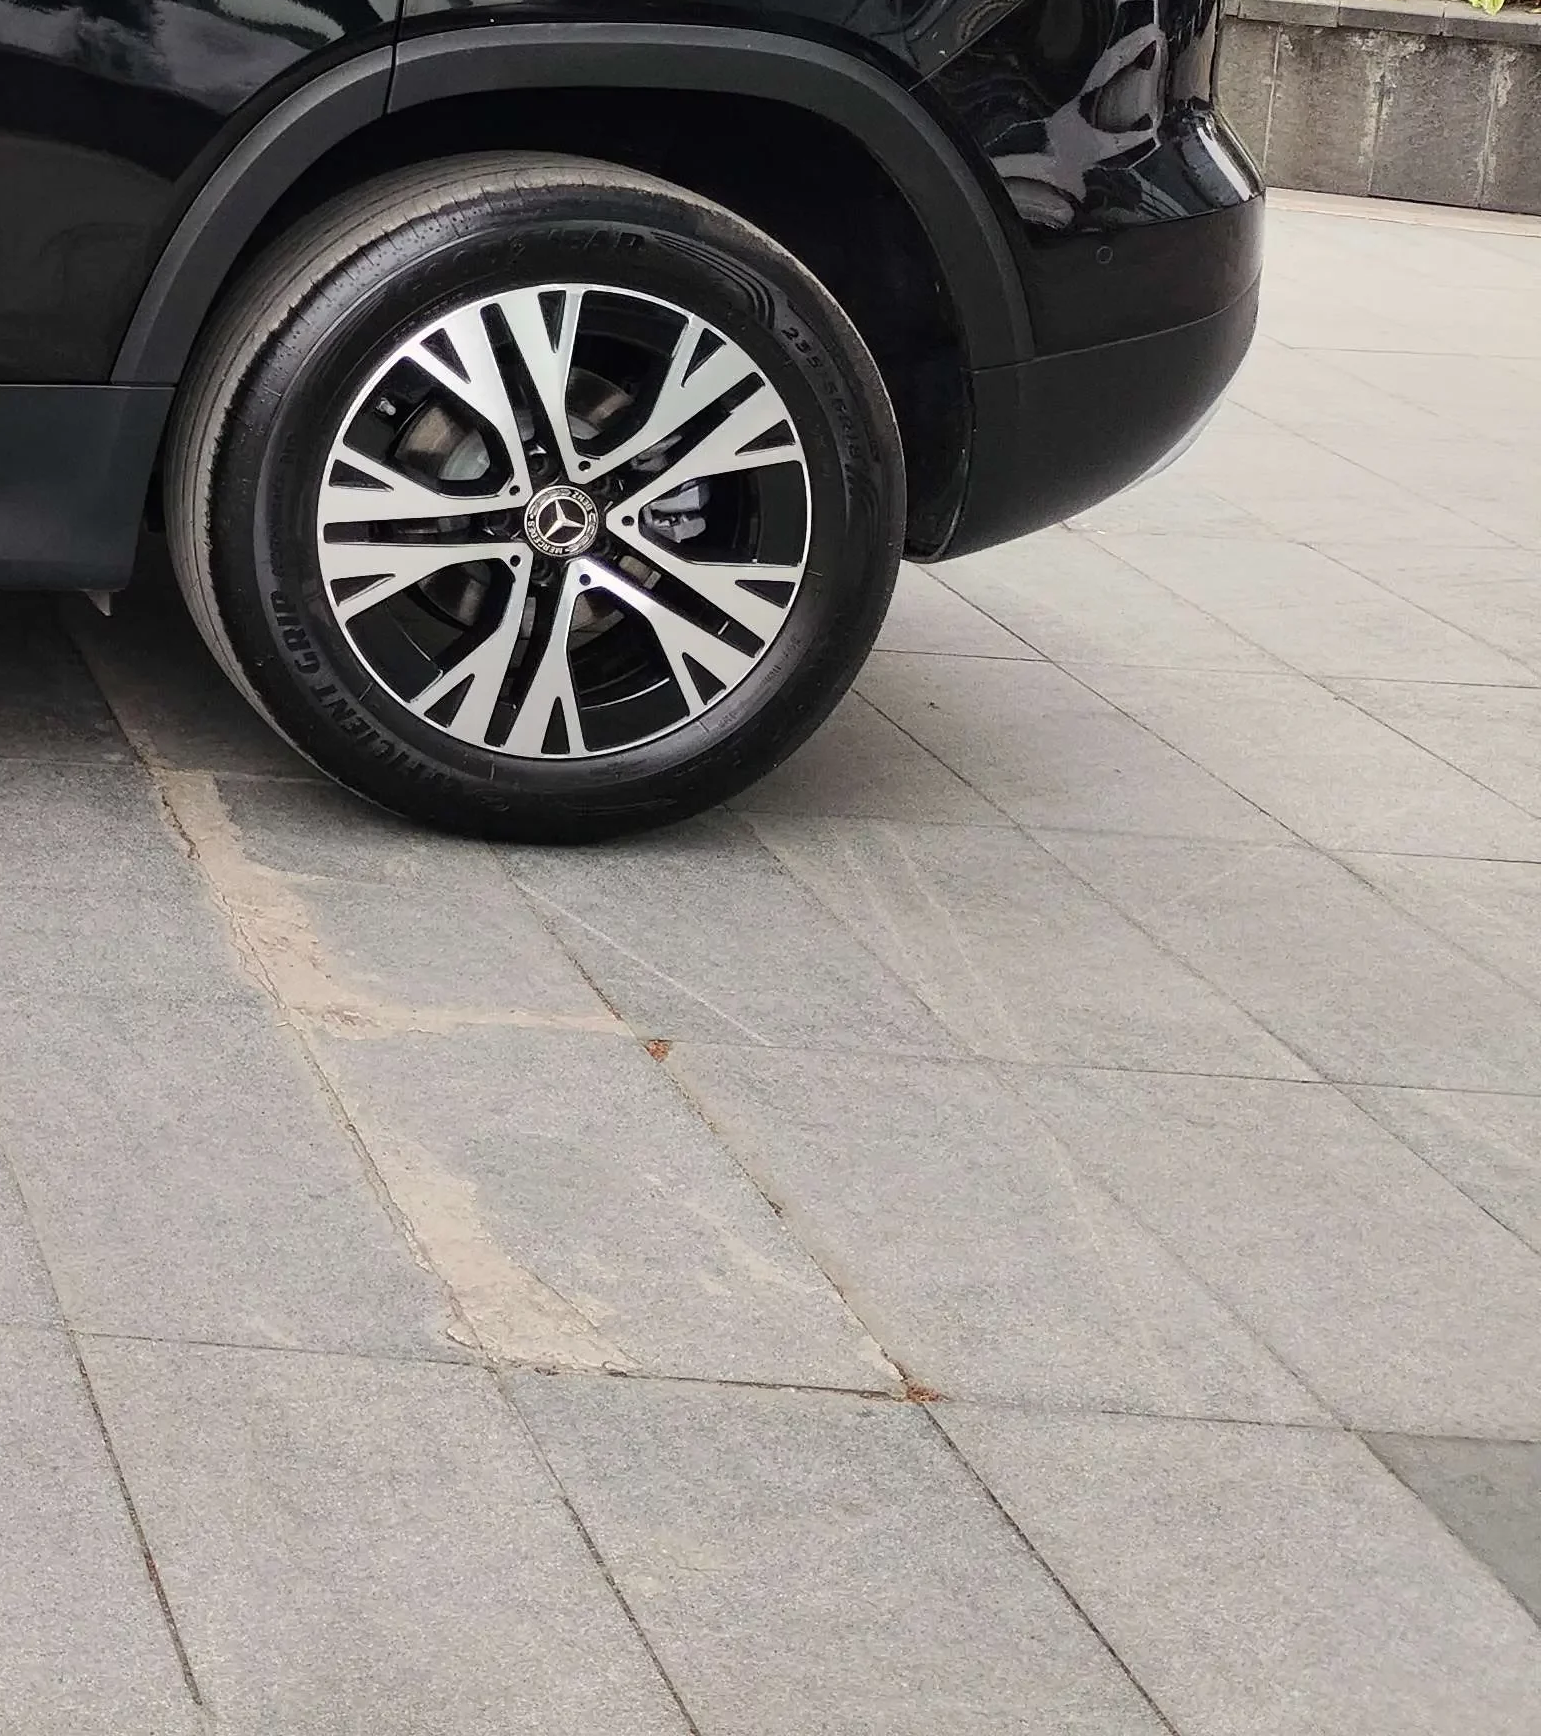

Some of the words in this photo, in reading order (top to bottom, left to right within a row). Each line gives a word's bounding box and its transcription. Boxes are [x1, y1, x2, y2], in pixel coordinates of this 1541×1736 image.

[571, 490, 593, 512] BENZ
[527, 520, 563, 555] MERCEDES
[270, 590, 321, 675] GRIP
